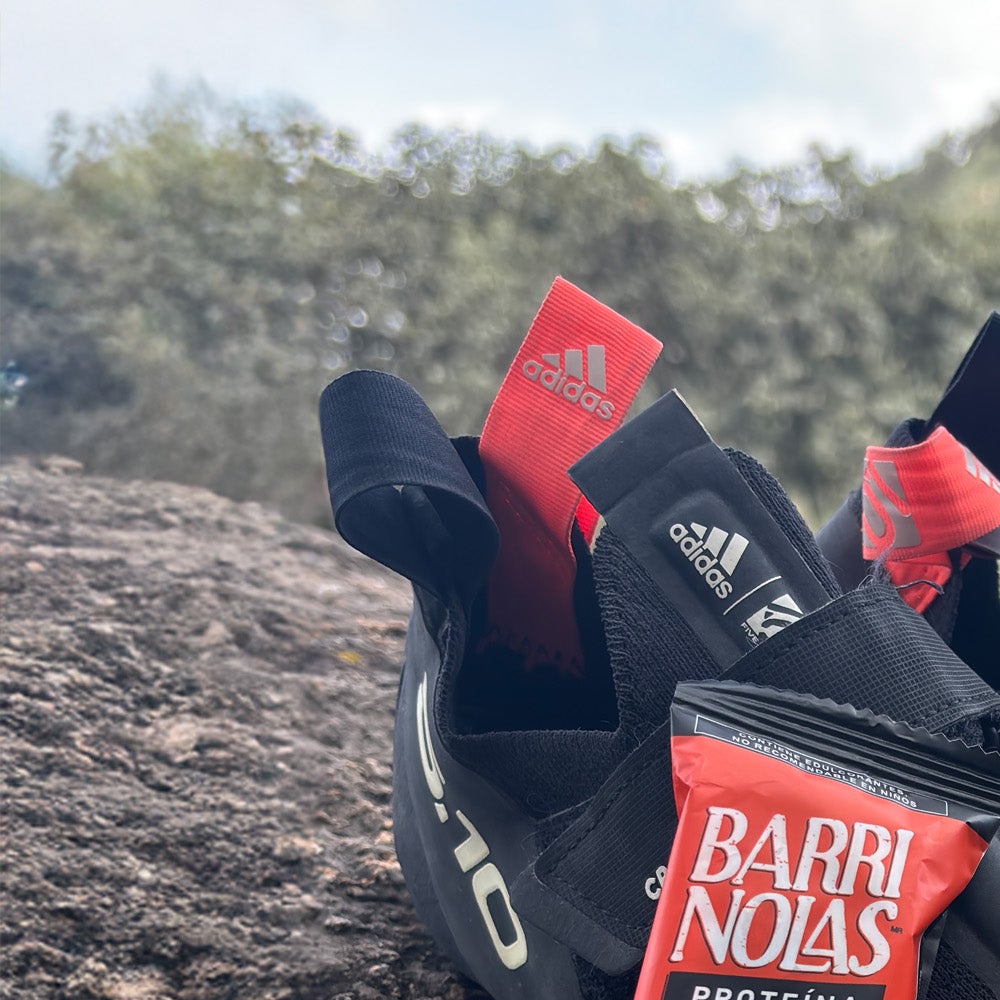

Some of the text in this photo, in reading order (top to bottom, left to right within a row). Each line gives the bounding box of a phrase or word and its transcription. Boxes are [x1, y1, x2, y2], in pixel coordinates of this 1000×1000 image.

[522, 360, 615, 420] adidas
[669, 523, 733, 599] adidas
[732, 735, 750, 746] NO
[754, 742, 857, 783] RECOMENDABLE
[861, 781, 876, 793] EN
[739, 732, 801, 760] CONTIENE
[688, 806, 914, 898] BARRI
[669, 886, 899, 977] NOLAS
